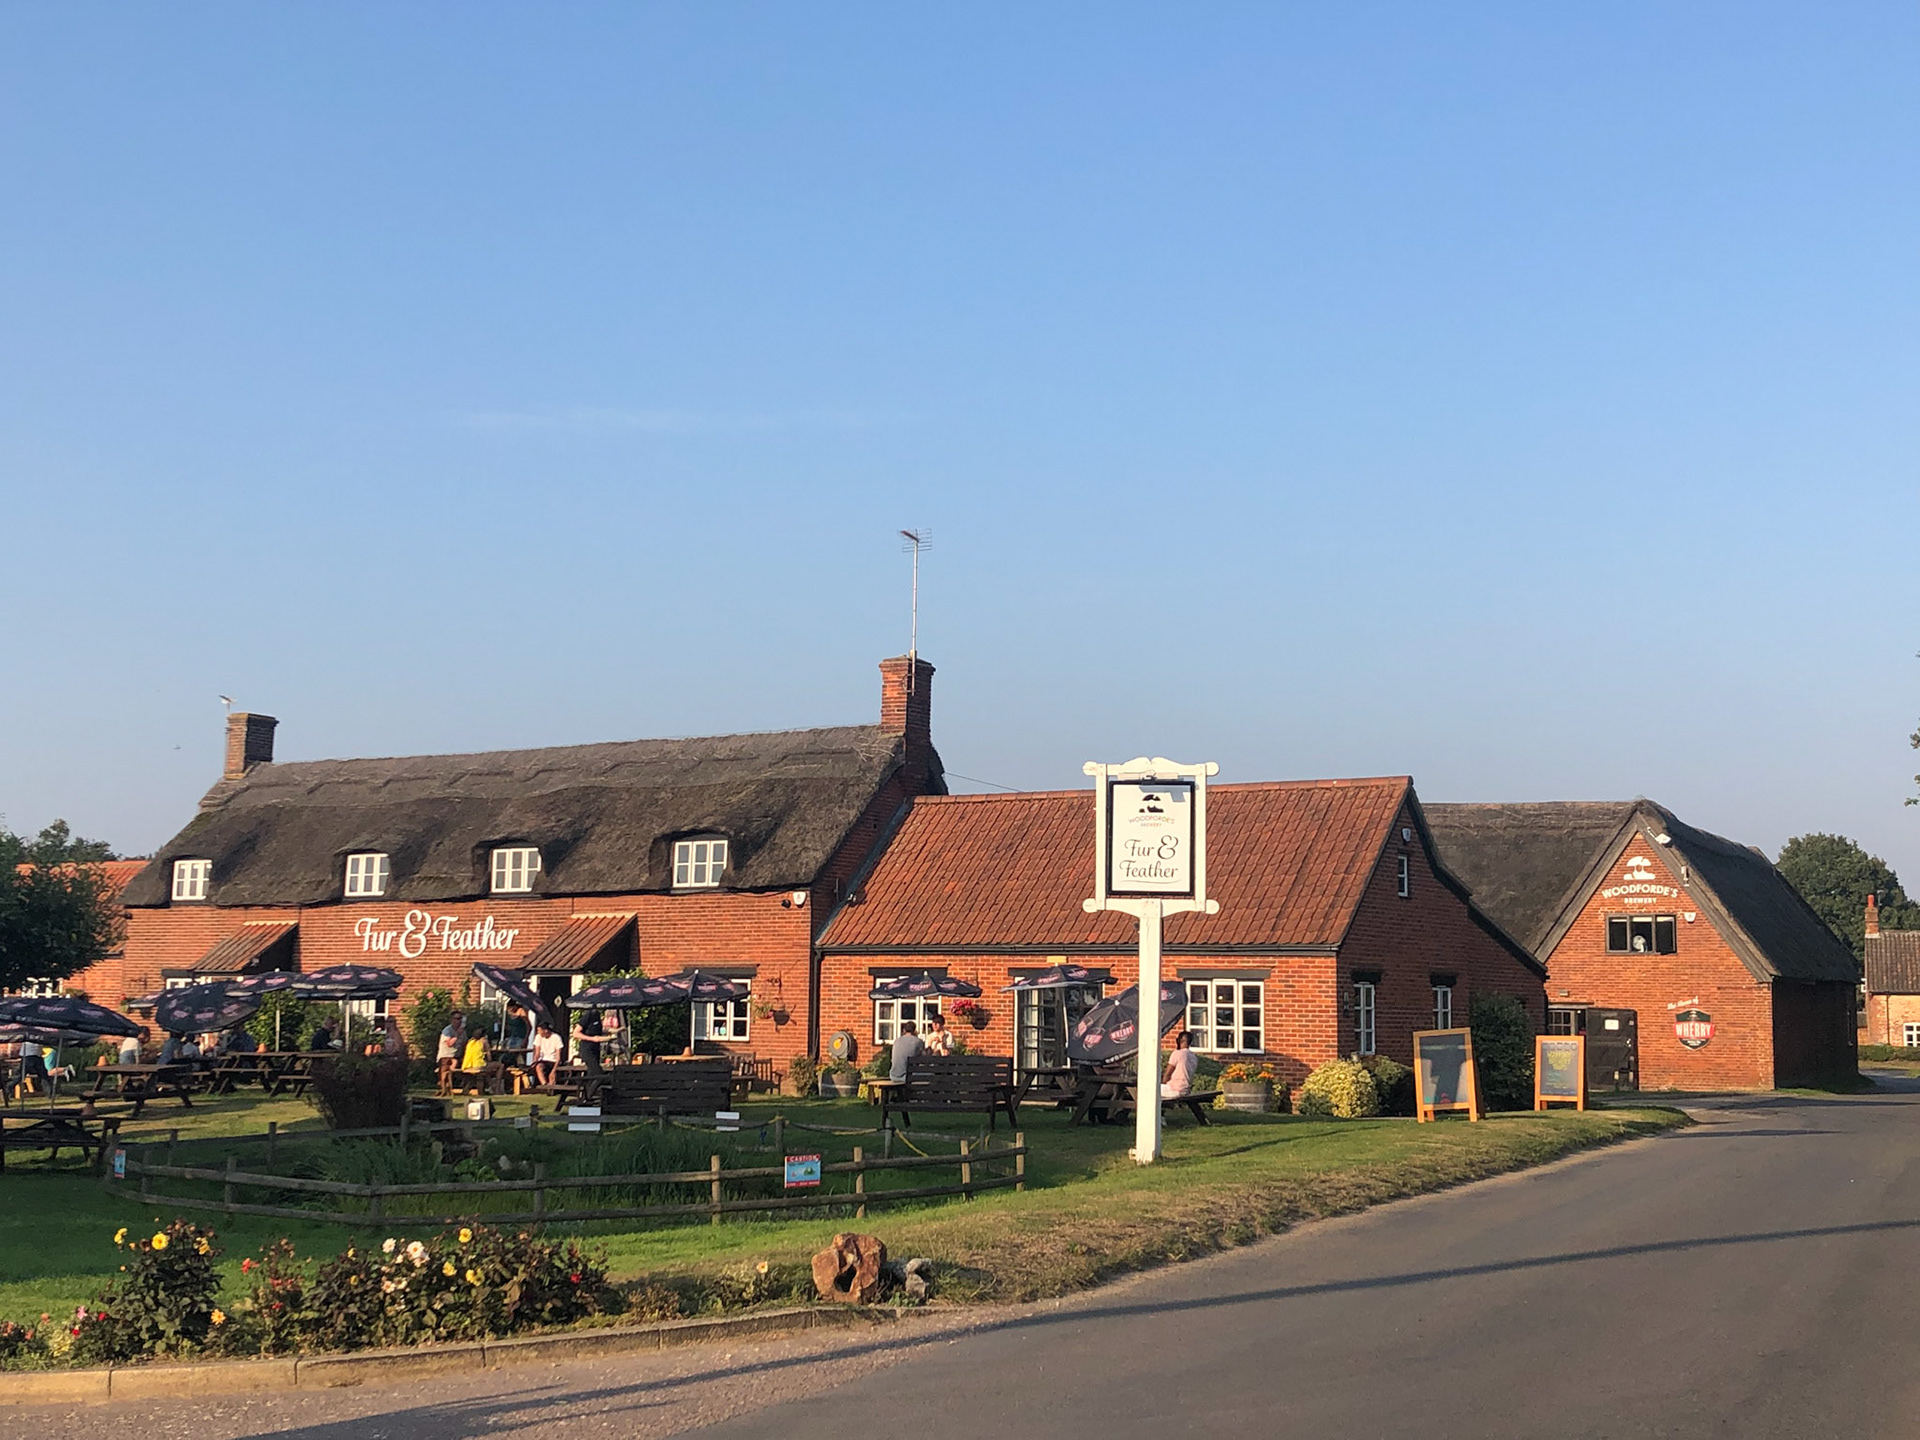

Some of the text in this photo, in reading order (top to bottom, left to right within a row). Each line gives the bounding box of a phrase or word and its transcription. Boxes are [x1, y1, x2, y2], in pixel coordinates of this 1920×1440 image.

[1124, 835, 1179, 860] Fur &
[1119, 859, 1179, 879] Feather
[1601, 884, 1679, 898] WOODFORDE'S
[354, 909, 519, 959] Fur & Feather
[1675, 1023, 1711, 1037] WHERRY
